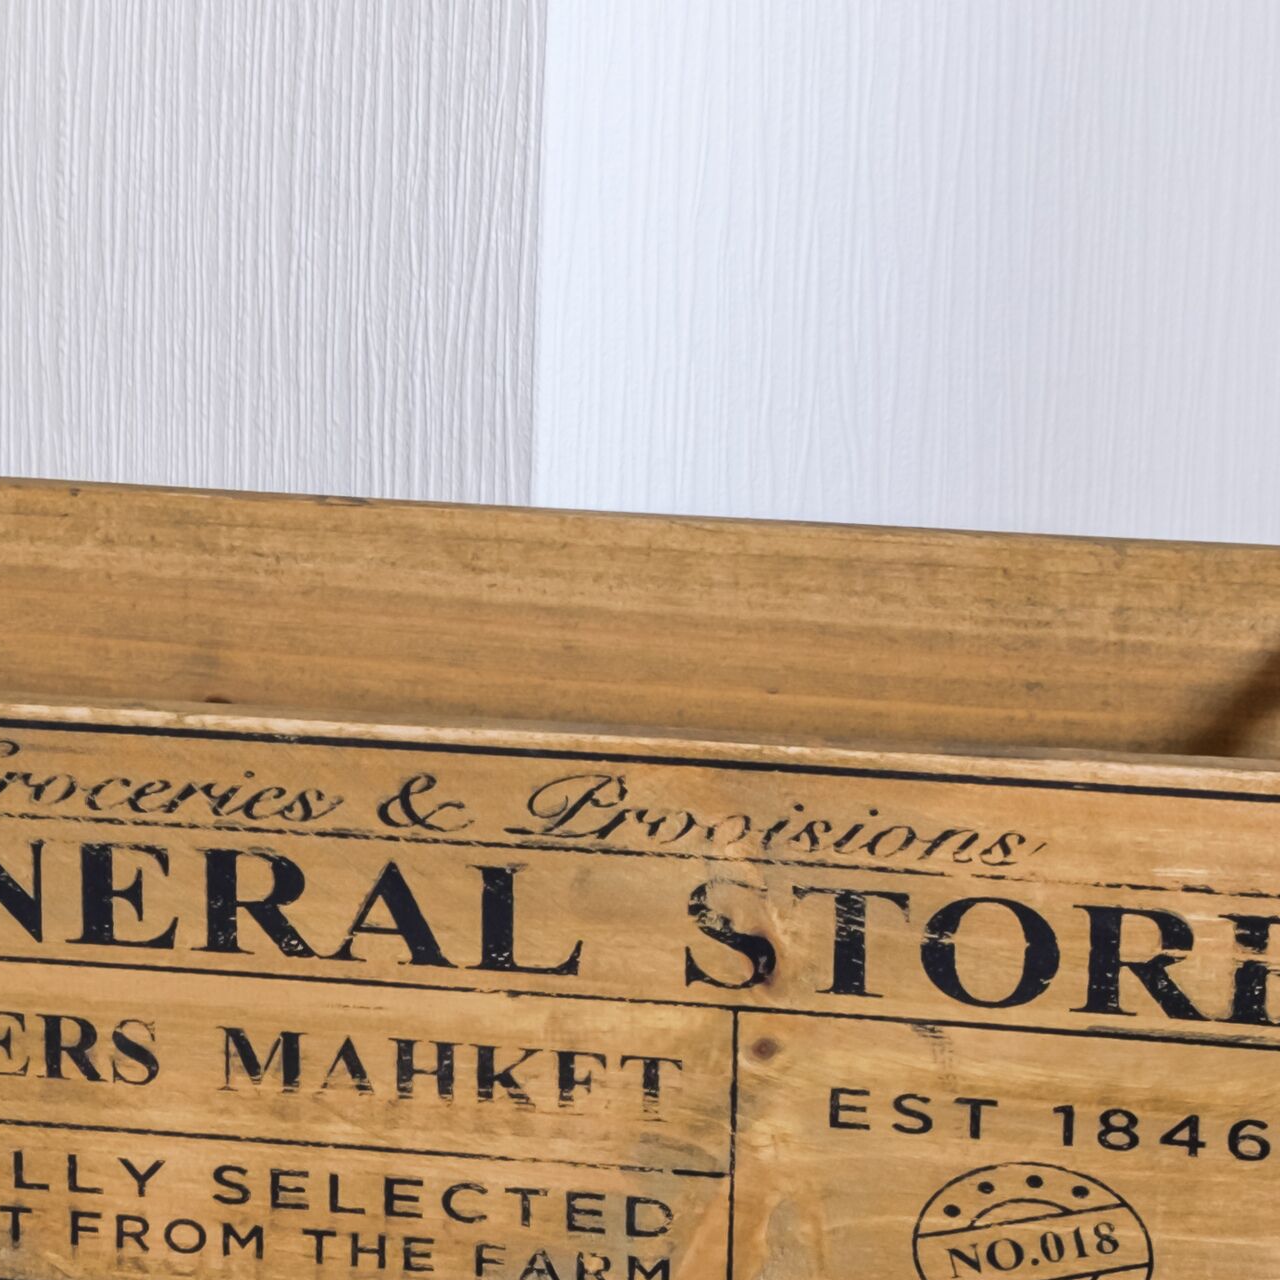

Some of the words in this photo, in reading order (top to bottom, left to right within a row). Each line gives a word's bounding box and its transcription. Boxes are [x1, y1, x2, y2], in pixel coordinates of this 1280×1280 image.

[376, 771, 475, 833] &
[830, 1087, 1000, 1140] EST
[1052, 1104, 1272, 1163] 1846
[213, 1163, 675, 1239] SELECTED
[70, 1210, 266, 1261] FROM
[302, 1227, 437, 1273] THE
[946, 1221, 1122, 1280] NO.018
